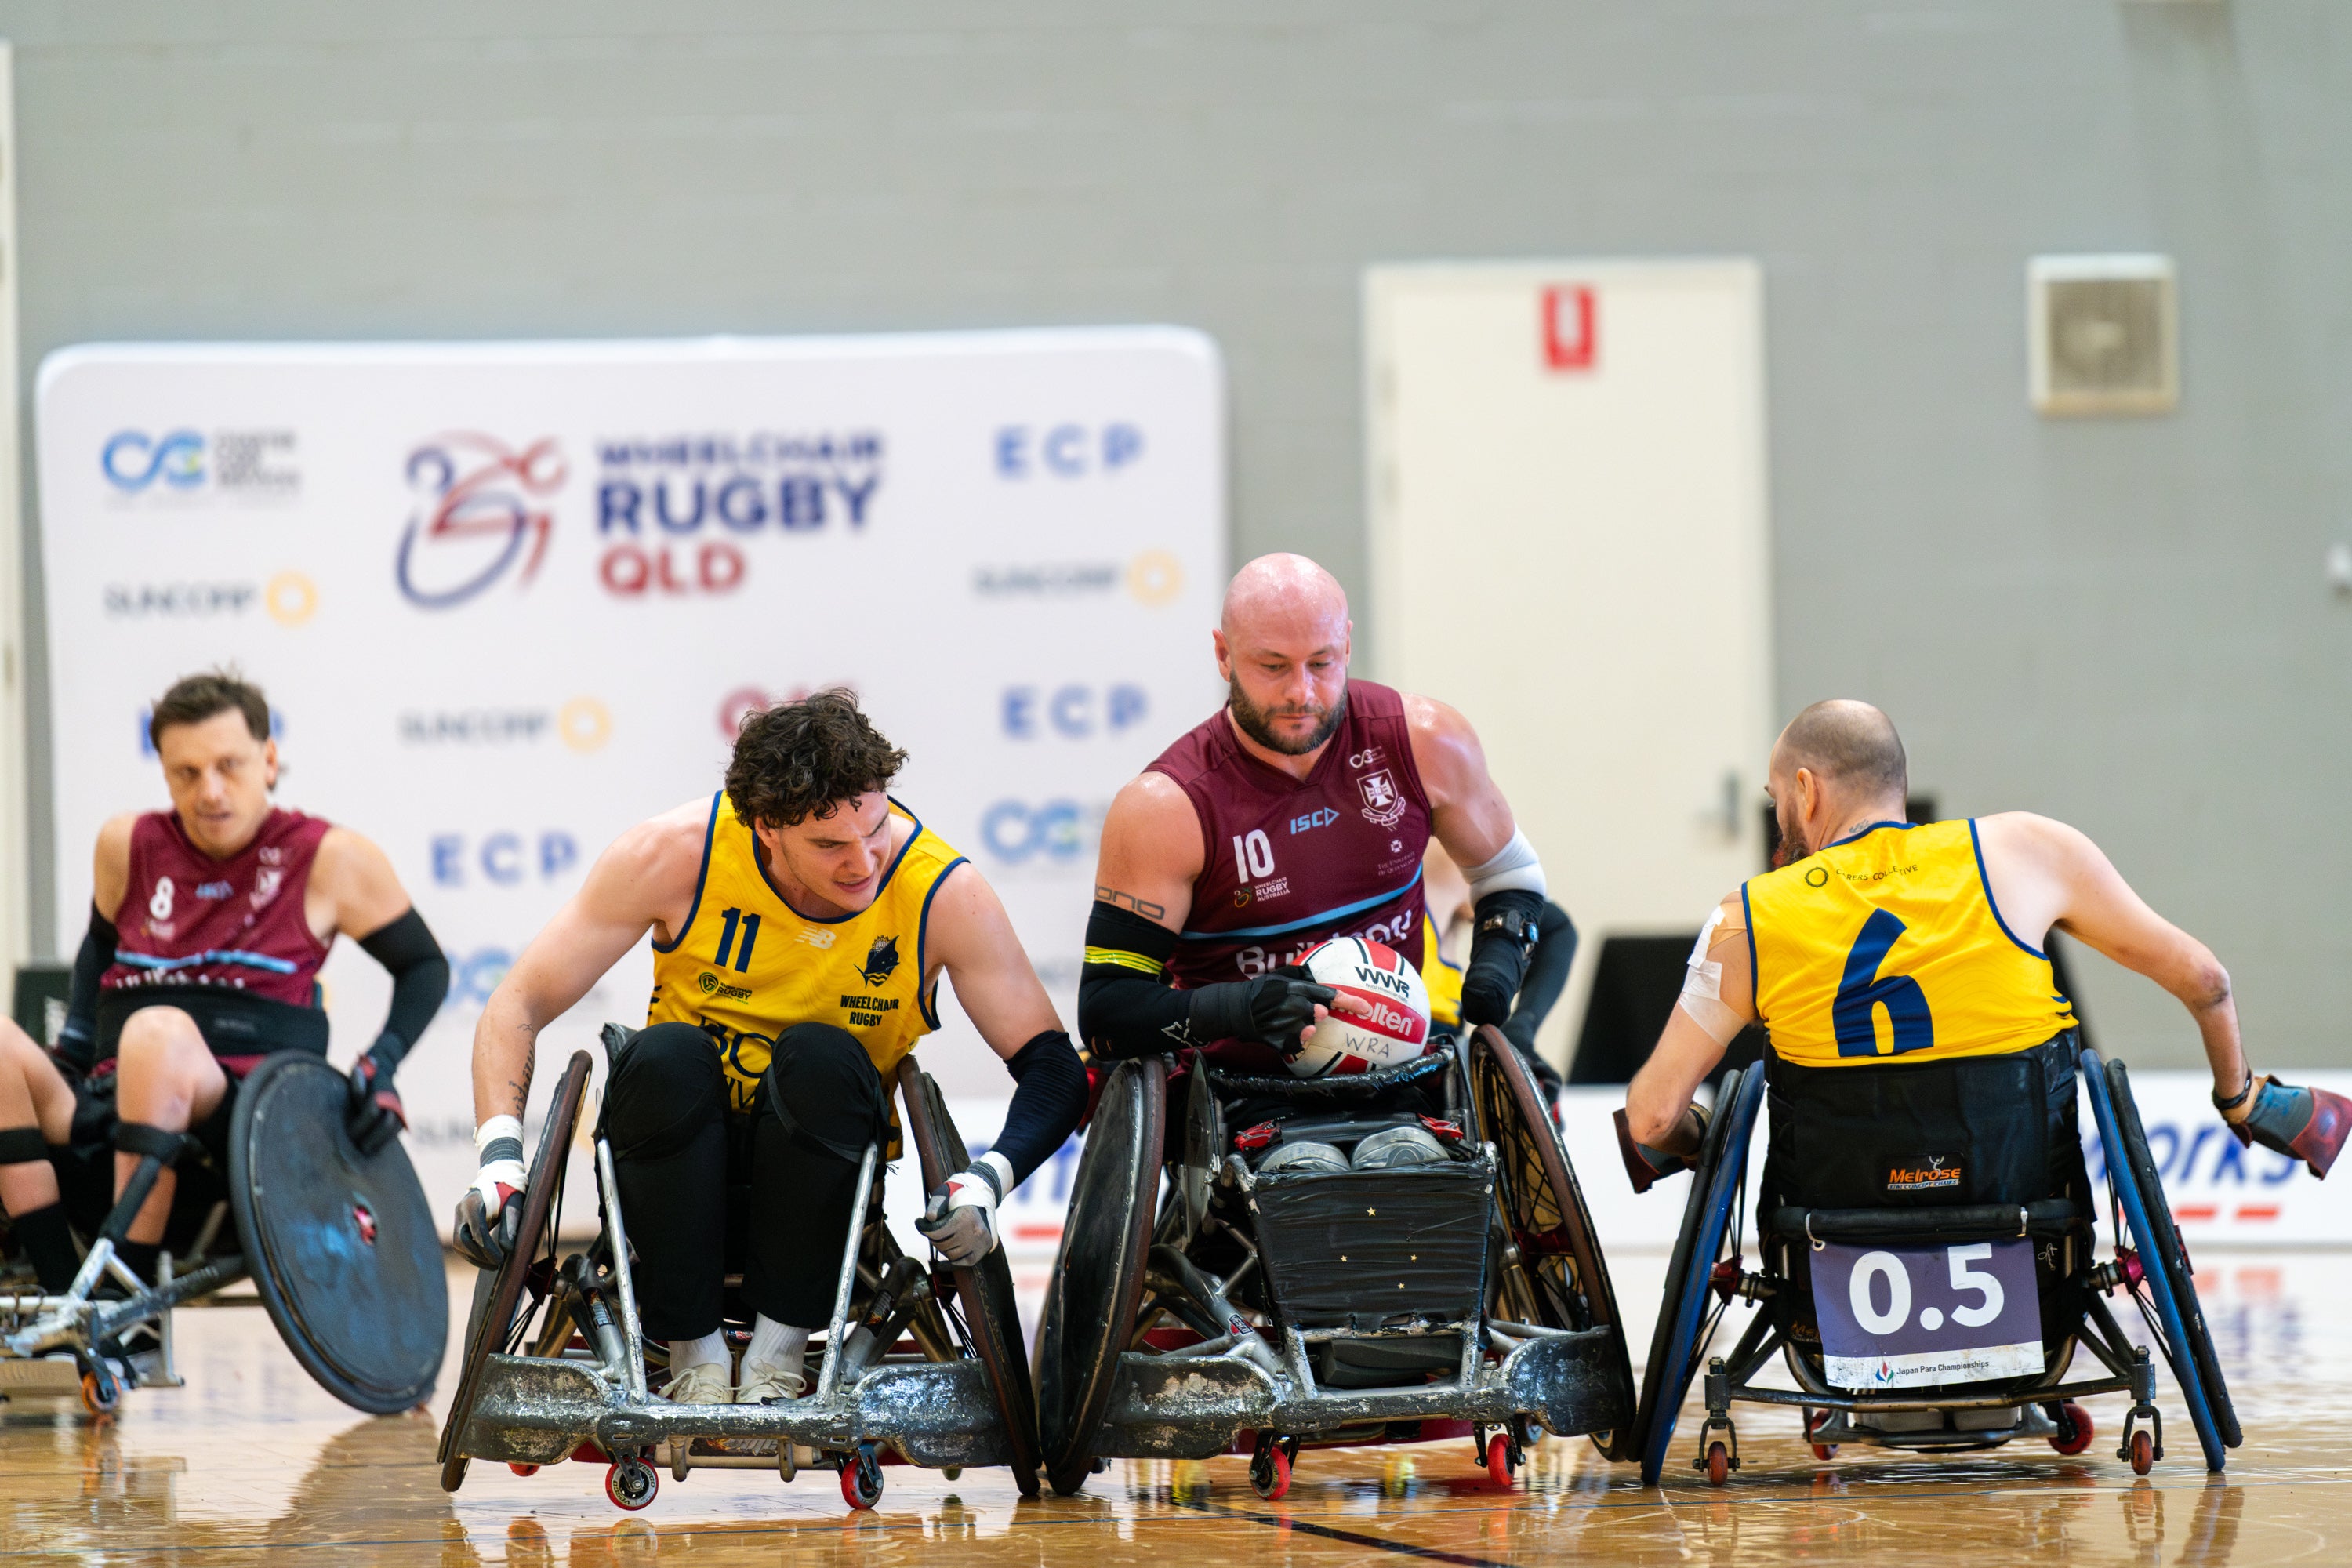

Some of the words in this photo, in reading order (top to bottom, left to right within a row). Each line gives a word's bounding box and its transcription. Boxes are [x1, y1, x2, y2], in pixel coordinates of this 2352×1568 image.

[994, 423, 1145, 479] ECP
[599, 474, 883, 533] RUGBY
[601, 543, 746, 594] QLD
[1001, 684, 1149, 739] ECP
[1290, 811, 1324, 835] ISC
[430, 831, 578, 886] ECP
[1232, 829, 1276, 884] 10
[149, 875, 175, 920] 8
[1254, 877, 1287, 890] WHEELCHAIR
[1255, 881, 1288, 897] RUGBY
[1257, 888, 1290, 902] AUSTRALIA
[714, 906, 761, 974] 11
[717, 986, 752, 1000] RUGBY
[1832, 907, 1934, 1058] 6
[840, 994, 899, 1012] WHEELCHAIR
[849, 1011, 883, 1027] RUGBY
[1346, 1033, 1390, 1058] WRA
[1889, 1167, 1962, 1184] Melrose
[1849, 1243, 2005, 1335] 0.5
[1896, 1367, 1919, 1376] Japan
[1920, 1365, 1936, 1374] Para
[1937, 1360, 1990, 1372] Championships
